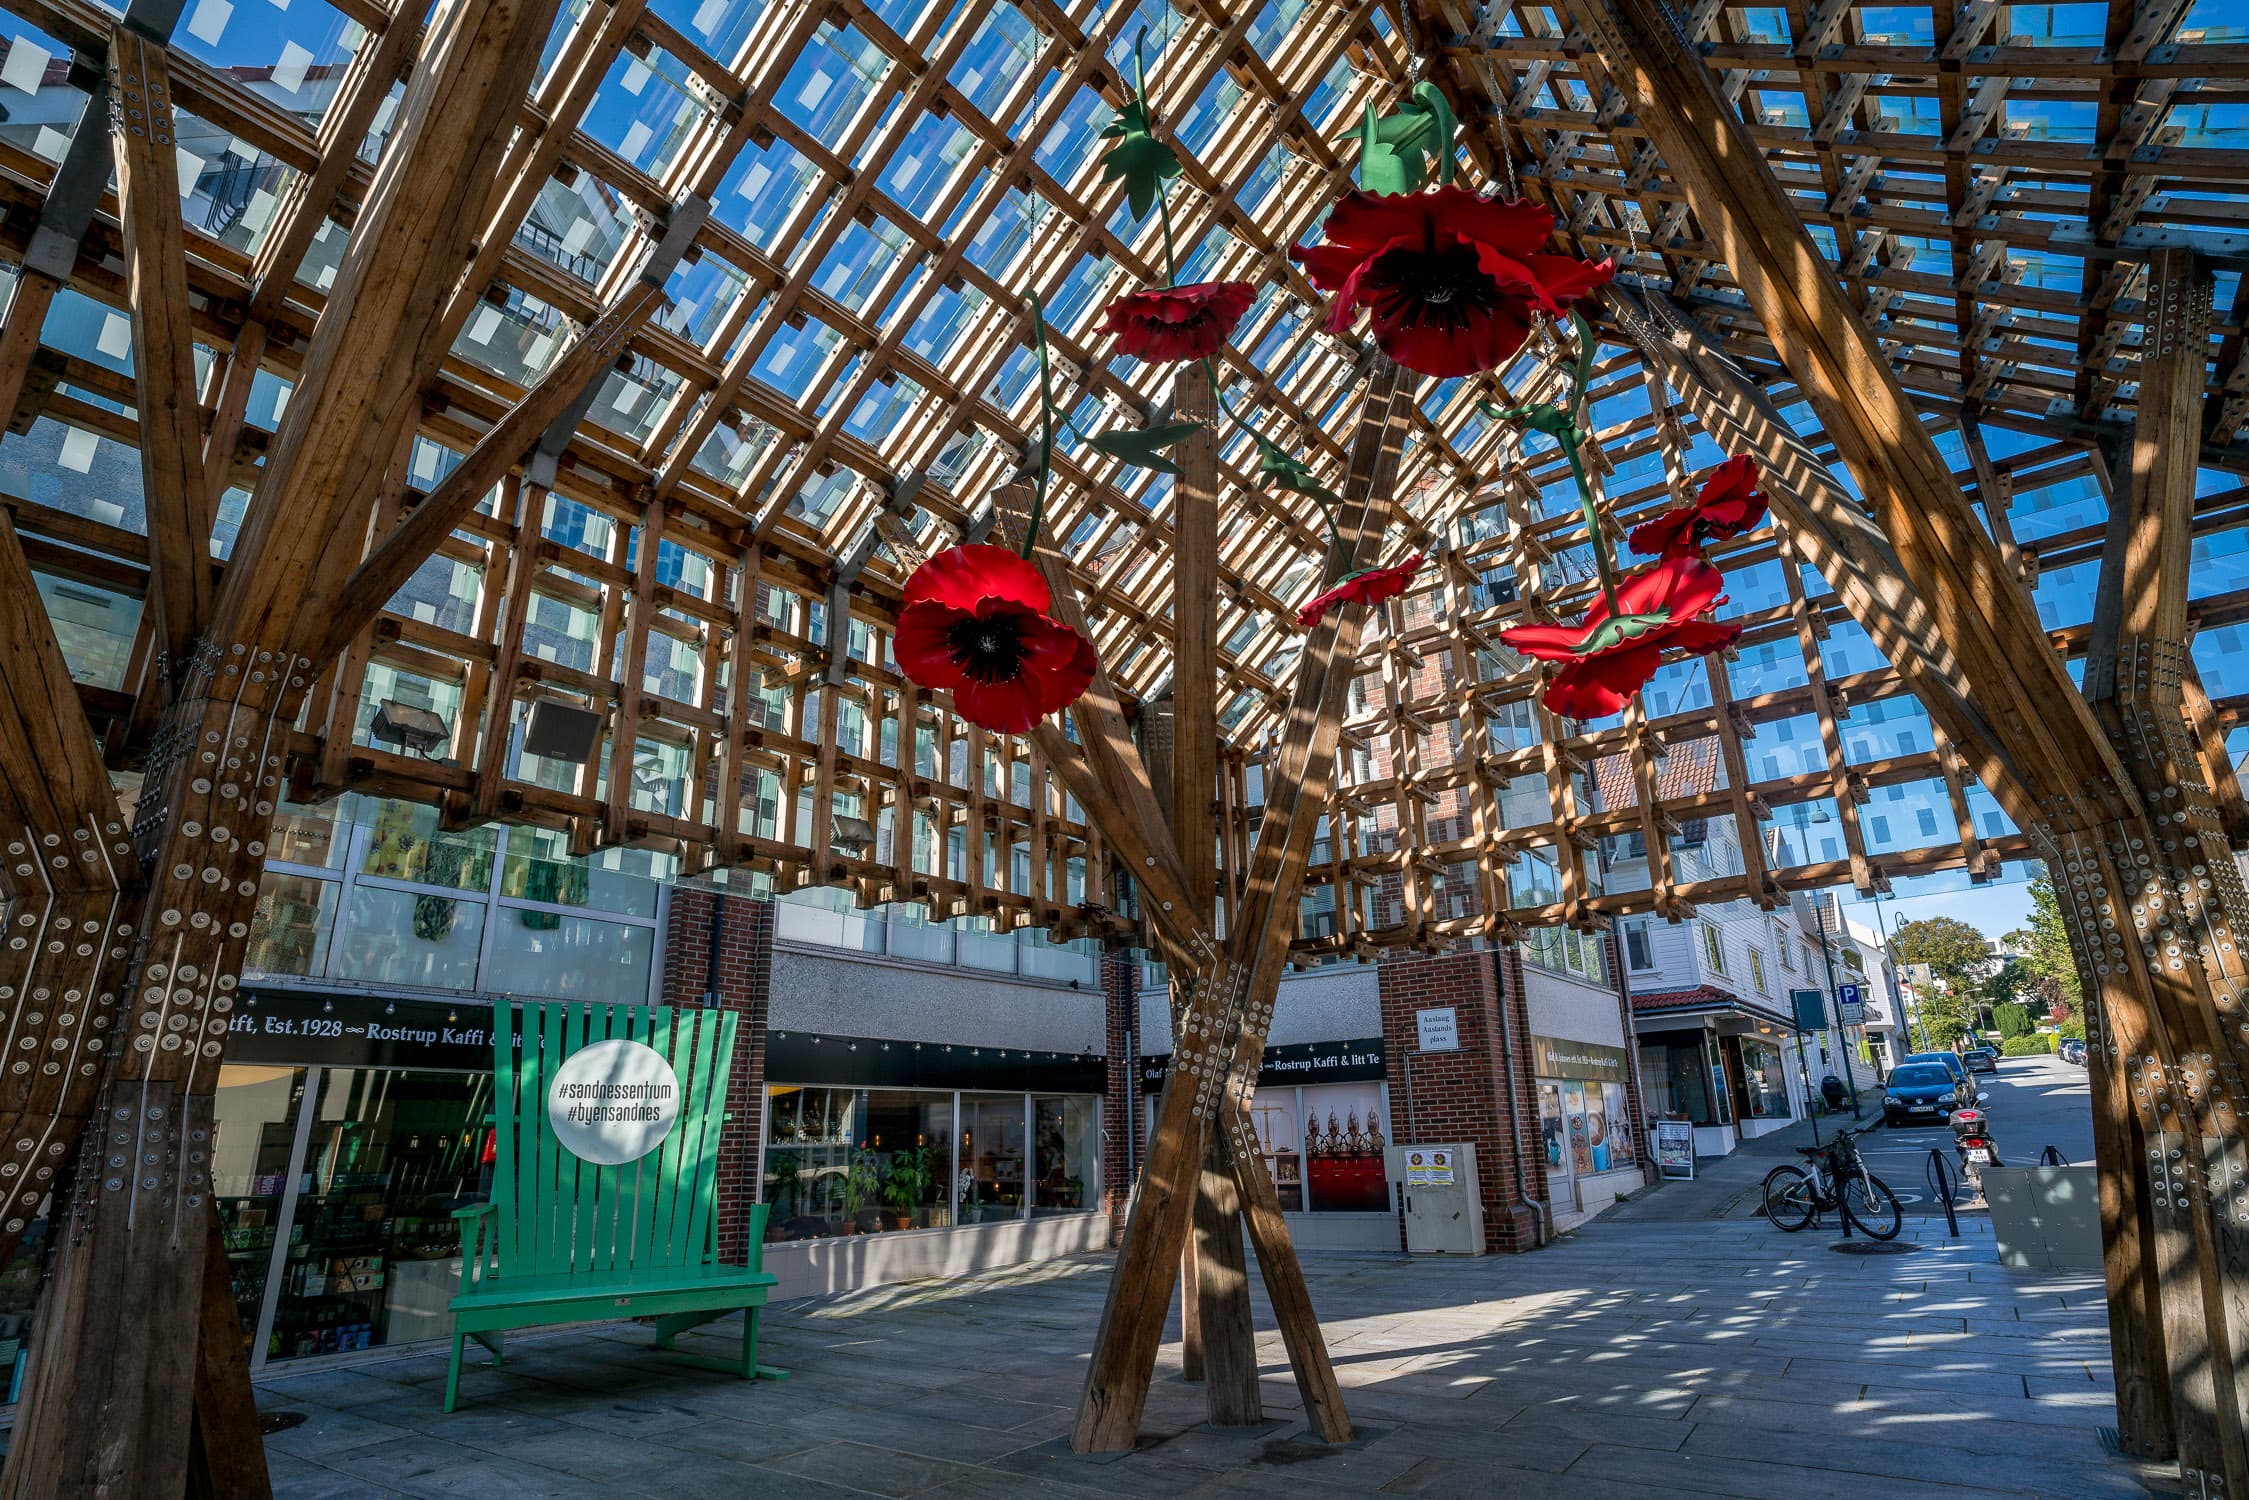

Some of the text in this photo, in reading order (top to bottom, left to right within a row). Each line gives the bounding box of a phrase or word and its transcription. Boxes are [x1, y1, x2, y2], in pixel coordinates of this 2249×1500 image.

[366, 1023, 437, 1047] Rostrup
[441, 1028, 484, 1046] Kaffi
[1430, 1035, 1447, 1044] plass
[1275, 1060, 1311, 1072] Rostrup
[1313, 1056, 1338, 1068] Kaffi
[1341, 1055, 1350, 1066] &
[1352, 1054, 1366, 1065] litt
[1367, 1053, 1380, 1064] Te
[1145, 1067, 1163, 1079] Olaf
[559, 1080, 672, 1099] #sandnessentrum
[567, 1102, 661, 1125] #byensandnes
